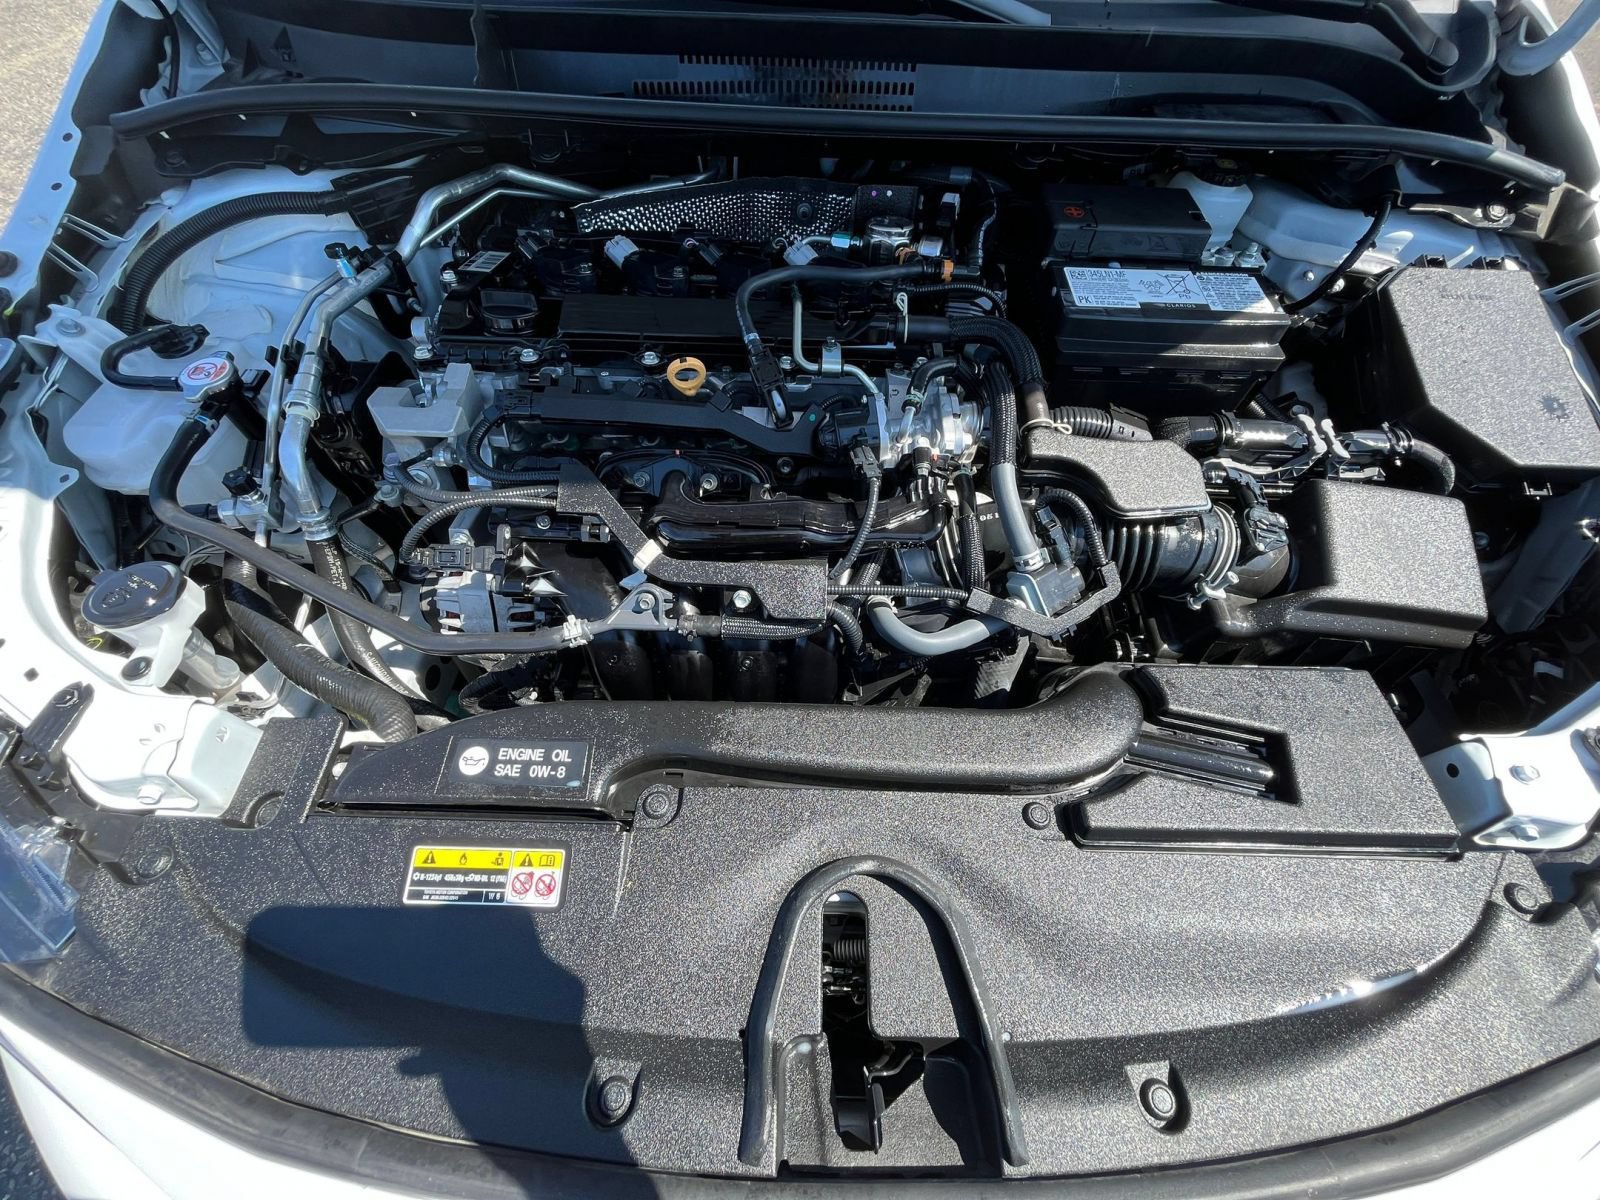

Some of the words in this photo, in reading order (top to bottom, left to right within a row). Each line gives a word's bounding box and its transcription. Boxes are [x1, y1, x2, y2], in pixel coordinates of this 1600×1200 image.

[1078, 295, 1092, 304] PK
[498, 747, 545, 762] ENGINE
[551, 749, 573, 762] OIL
[494, 763, 522, 777] SAE
[529, 765, 567, 779] 0W-8
